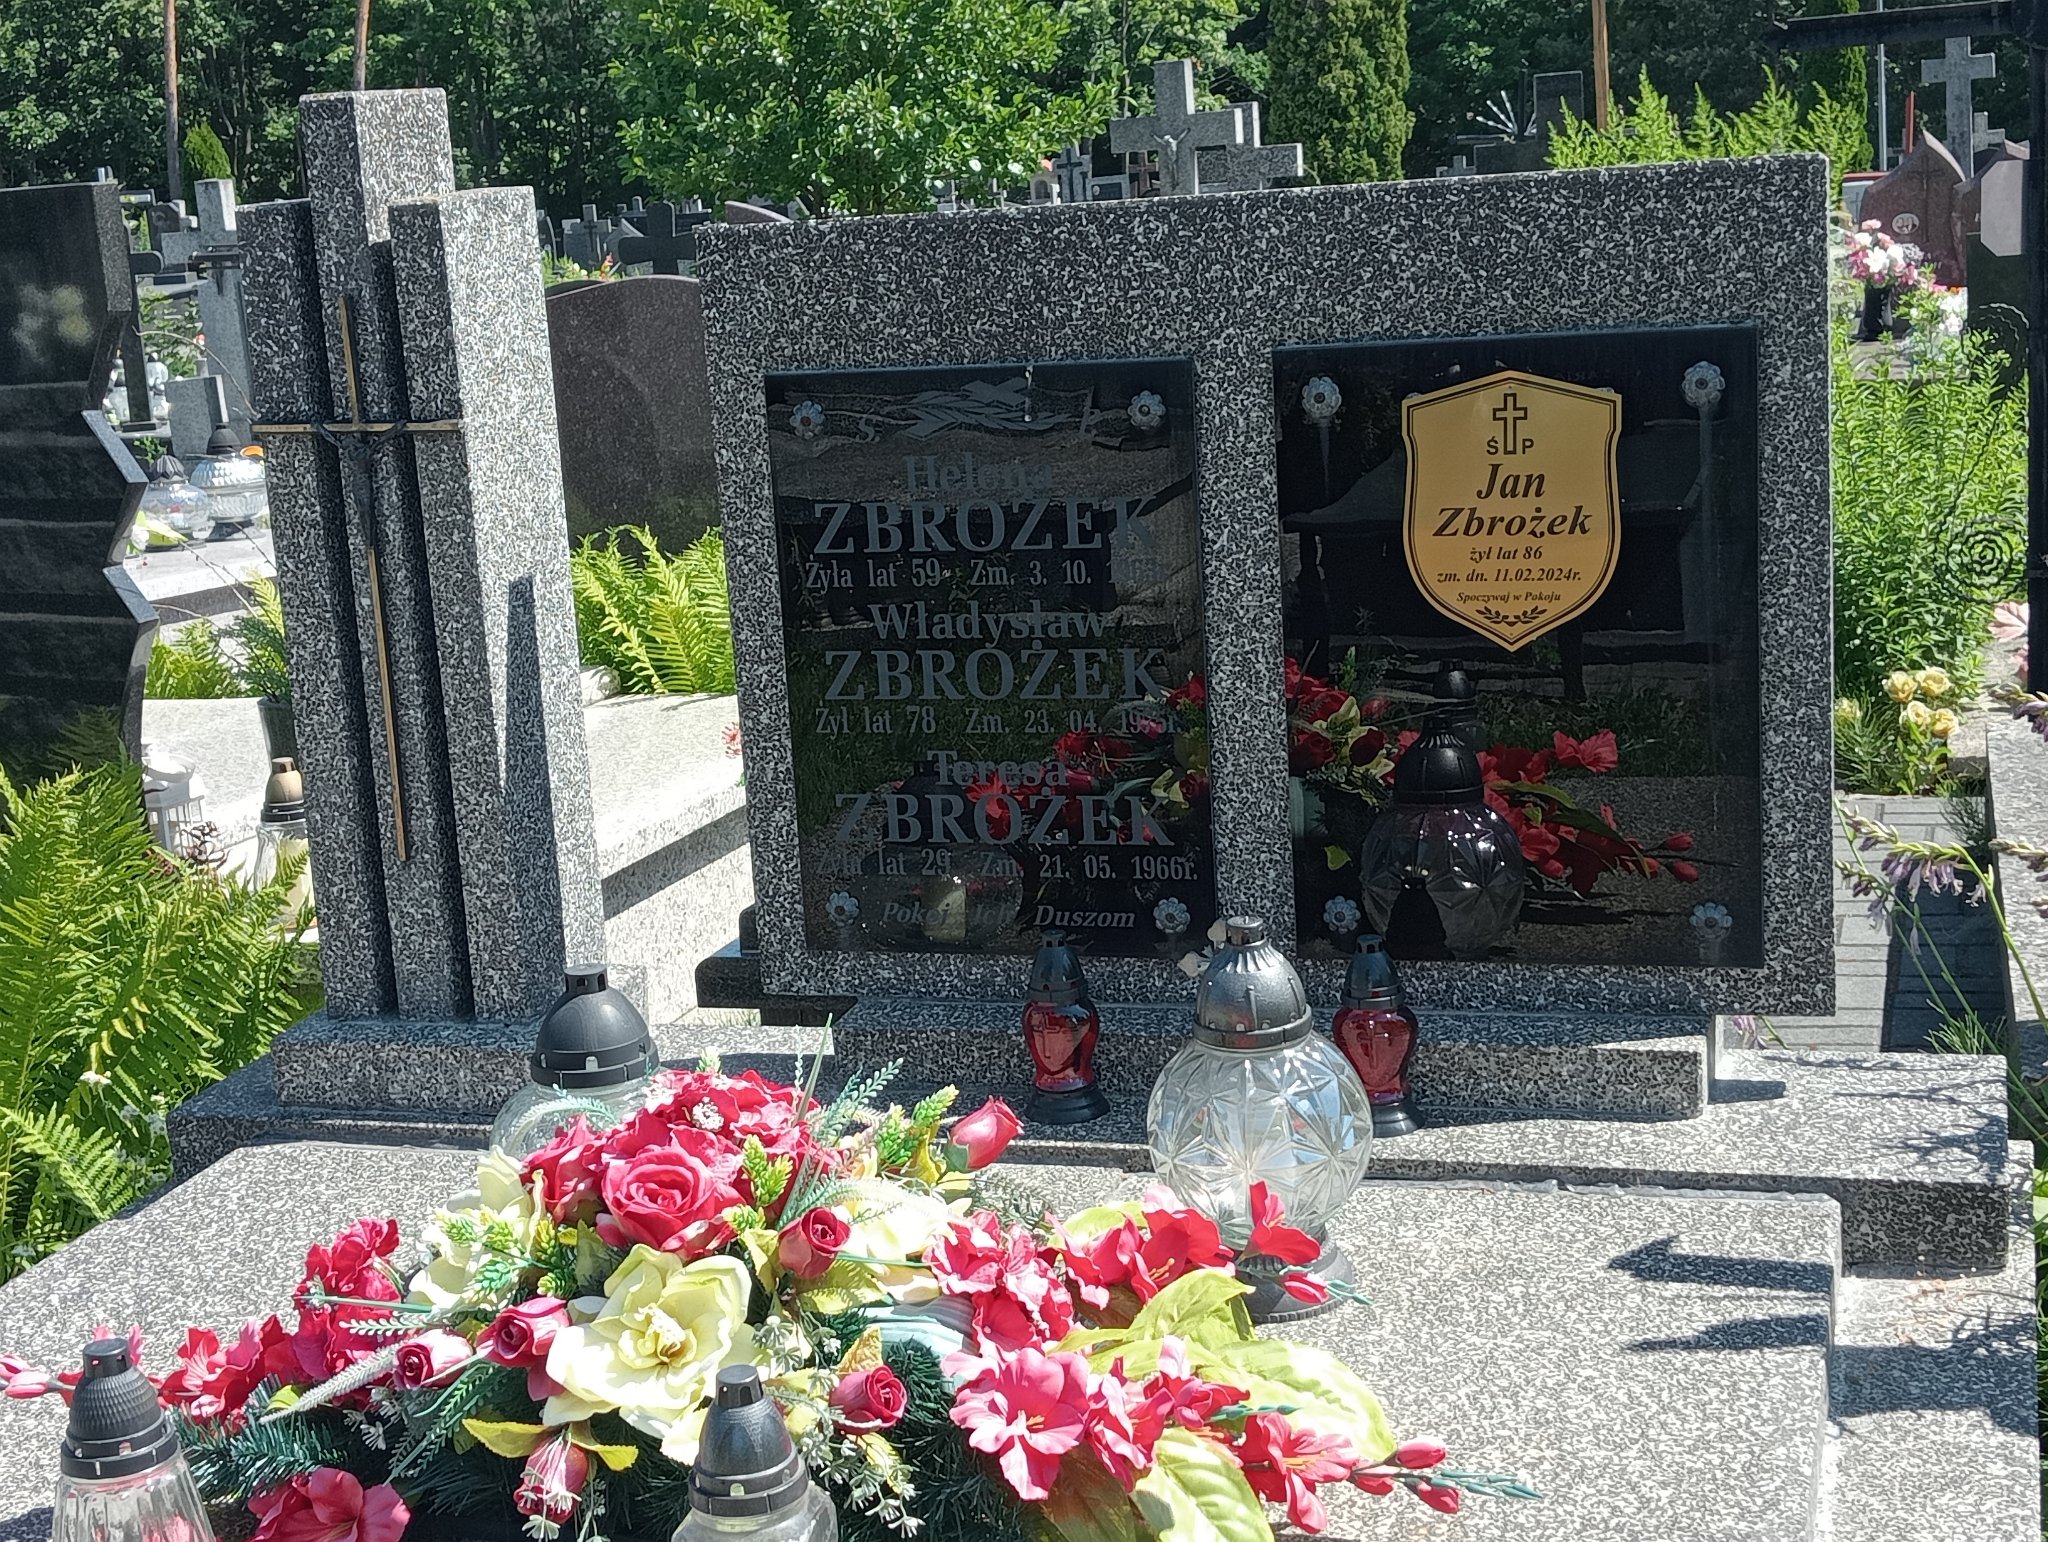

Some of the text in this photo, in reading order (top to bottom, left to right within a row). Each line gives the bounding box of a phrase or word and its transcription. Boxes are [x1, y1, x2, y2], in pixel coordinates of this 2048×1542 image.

[905, 452, 1055, 493] Helena
[1476, 462, 1546, 500] Jan
[813, 490, 1157, 554] ZBROŻEK
[1432, 504, 1593, 539] Zbrożek
[1469, 545, 1543, 562] żył lat 86
[867, 559, 898, 587] lat
[911, 558, 941, 587] 59
[971, 560, 1014, 587] Zm.
[1029, 560, 1048, 586] 3.
[1062, 559, 1091, 585] 10.
[1436, 567, 1582, 584] zm. dn. 11.02.2024r.
[1456, 591, 1561, 604] Spoczywaj w Pokoju
[869, 600, 1108, 648] Władysław
[824, 640, 1168, 701] ZBROŻEK
[863, 706, 893, 734] lat
[906, 705, 936, 735] 78
[965, 707, 1010, 735] Zm.
[1024, 709, 1055, 735] 23.
[1069, 709, 1103, 735] 04.
[927, 750, 1070, 787] Teresa
[836, 786, 1175, 846] ZBROŻEK
[878, 847, 906, 876] lat
[921, 848, 952, 877] 29
[980, 852, 1024, 878] Zm.
[1039, 855, 1070, 880] 21.
[1085, 856, 1117, 880] 05.
[1132, 856, 1199, 882] 1966r.
[1034, 905, 1136, 930] Duszom
